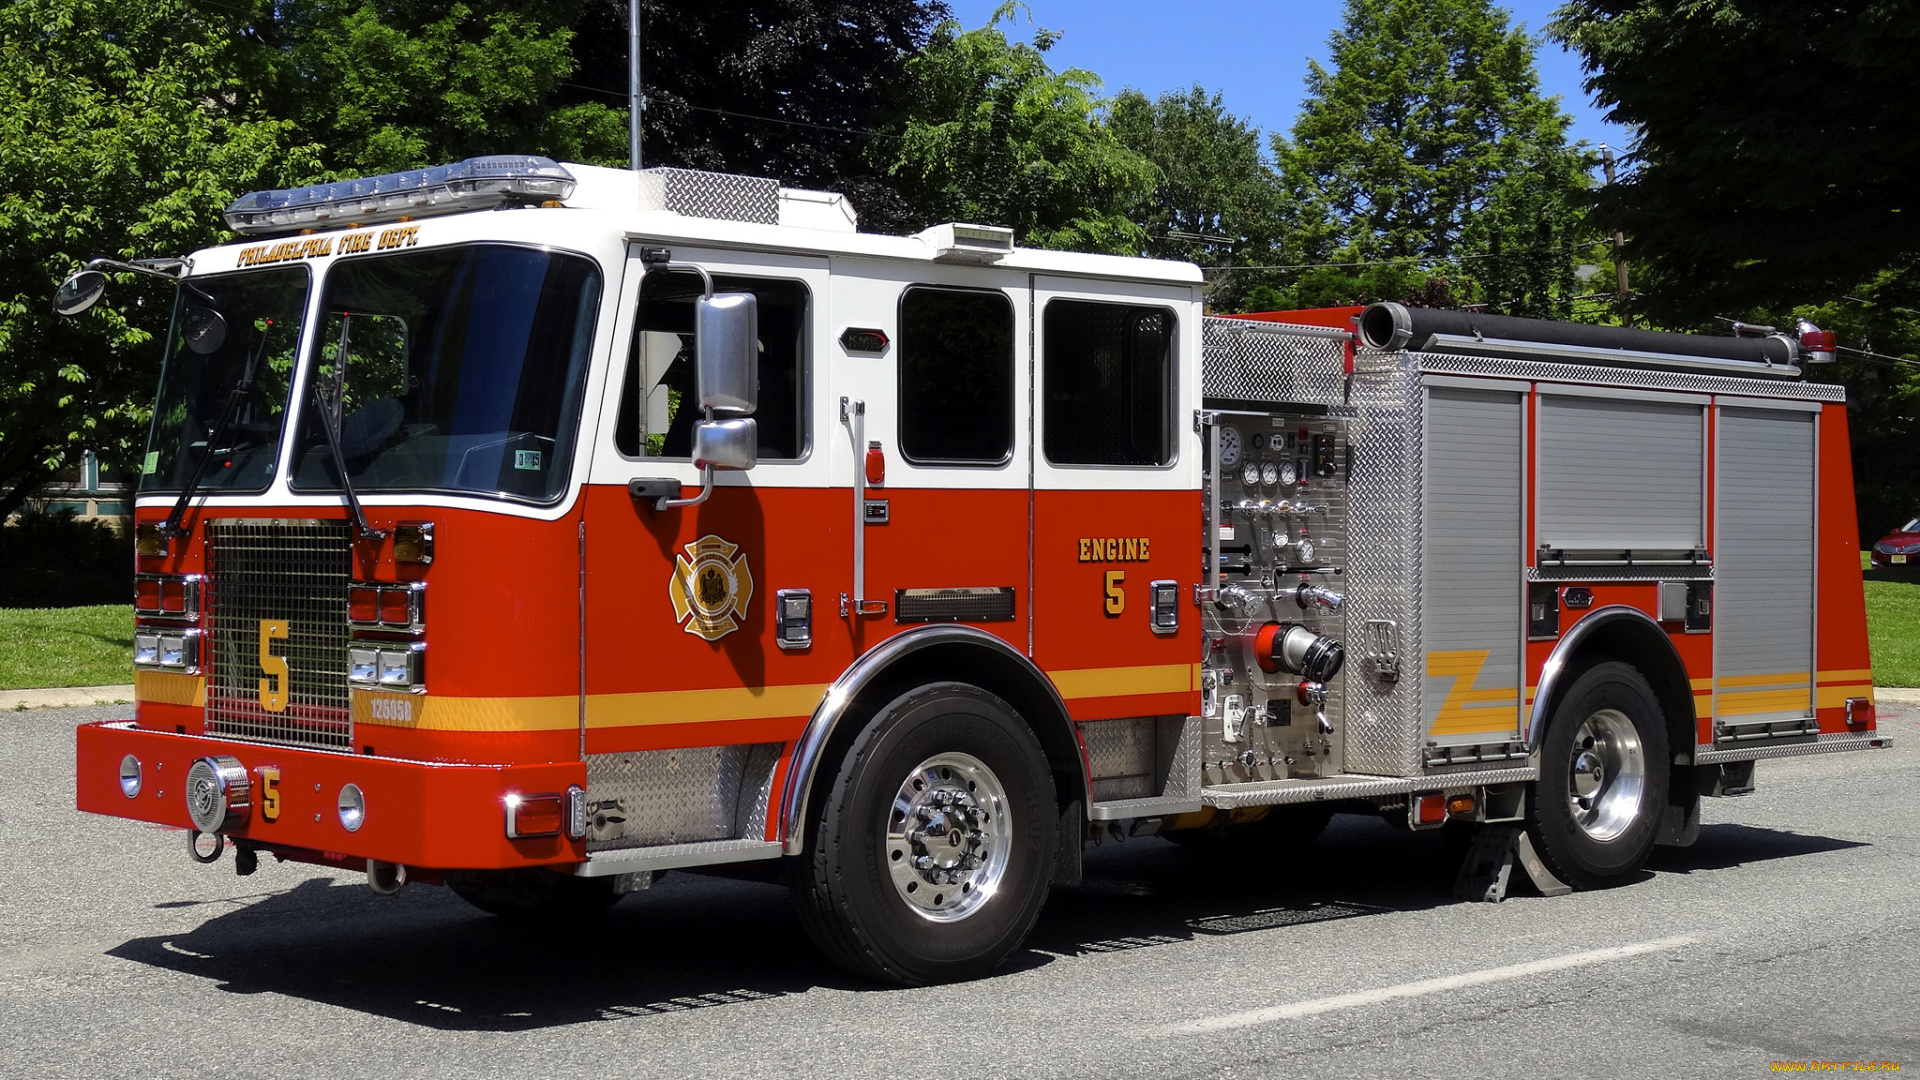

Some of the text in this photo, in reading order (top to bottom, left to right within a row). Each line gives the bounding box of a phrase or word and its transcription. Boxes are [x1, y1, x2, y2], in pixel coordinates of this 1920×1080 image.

[237, 225, 421, 267] PHILADELPHIA FIRE DEPT.
[848, 335, 879, 345] KME
[1079, 537, 1150, 562] ENGINE
[1104, 569, 1125, 616] 5
[259, 619, 289, 712] 5
[371, 698, 412, 722] 126058
[263, 769, 280, 820] 5
